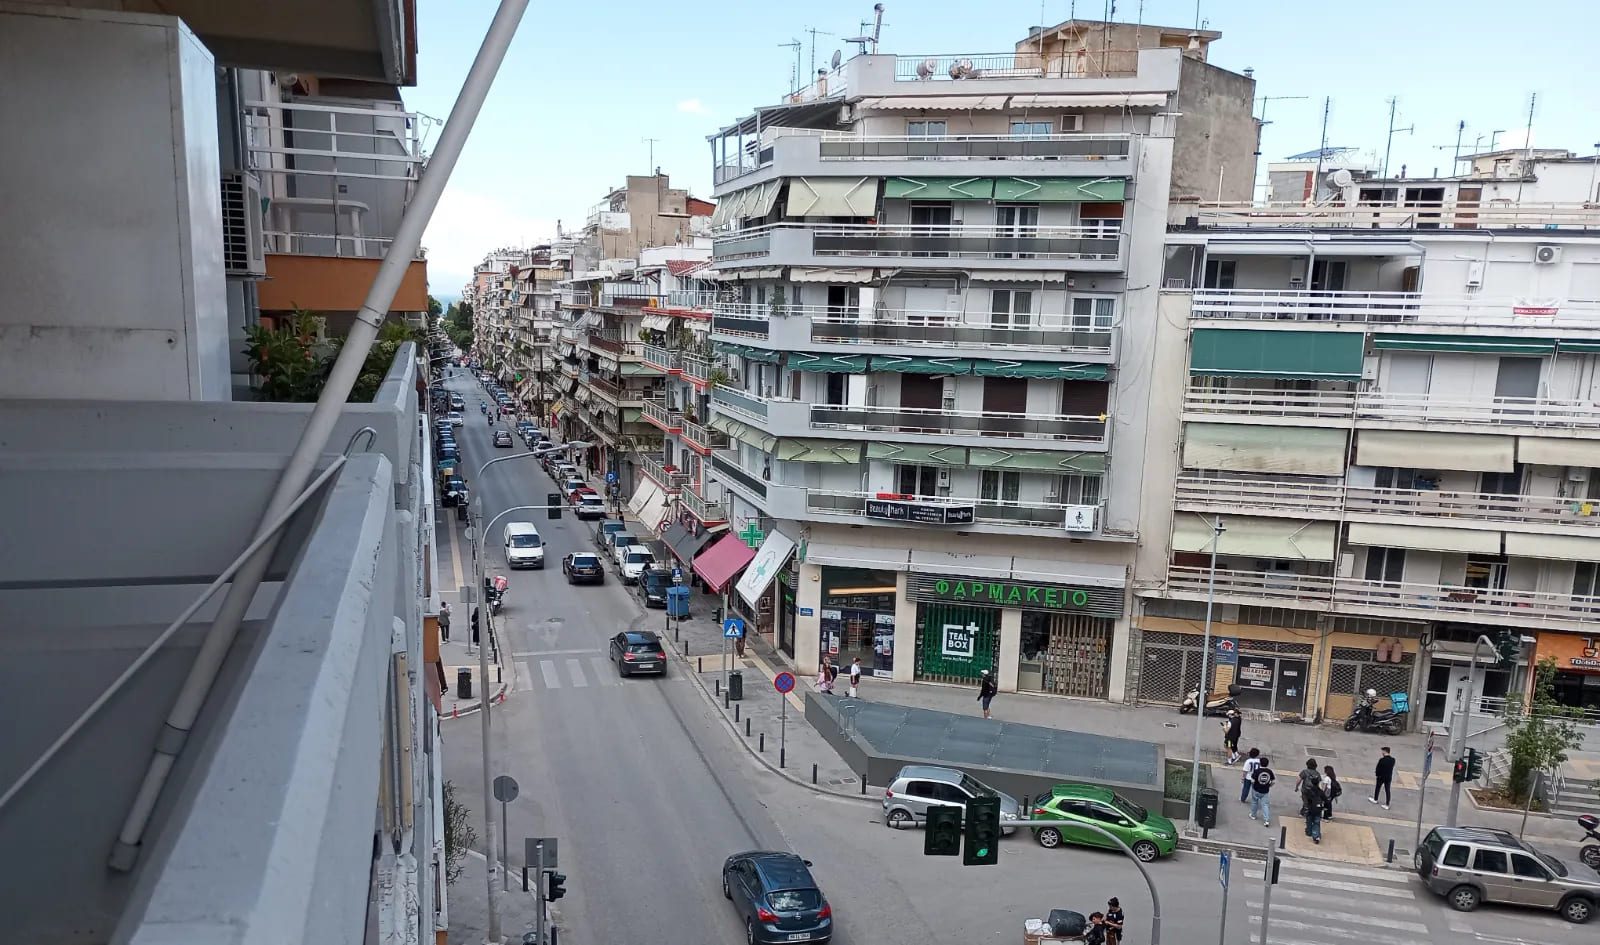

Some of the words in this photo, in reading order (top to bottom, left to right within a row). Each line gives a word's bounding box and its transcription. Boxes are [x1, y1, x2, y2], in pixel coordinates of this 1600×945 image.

[935, 579, 1088, 606] ΦΑΡΜΑΚΕΙΟ
[949, 632, 968, 641] TEAL
[948, 640, 967, 649] BOX
